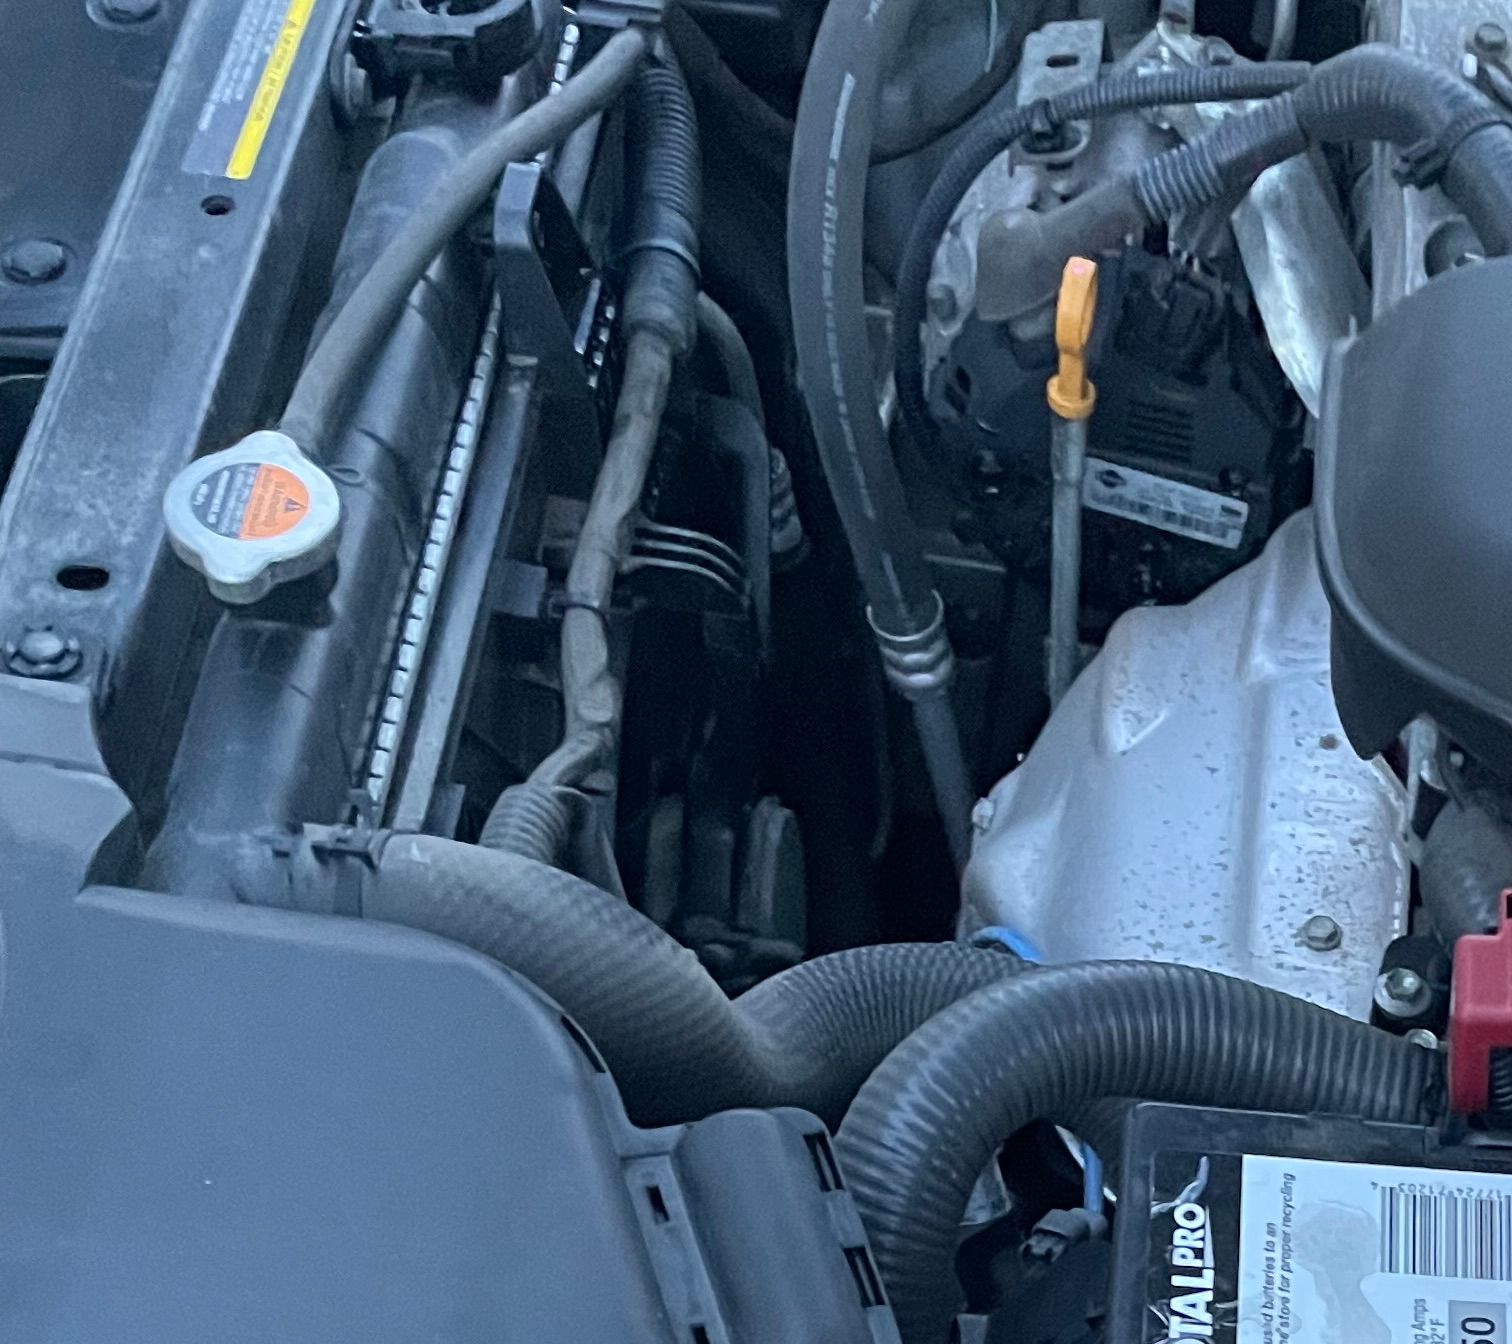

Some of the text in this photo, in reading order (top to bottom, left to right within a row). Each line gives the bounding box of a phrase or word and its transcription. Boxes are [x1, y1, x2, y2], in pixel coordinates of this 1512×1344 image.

[1279, 1172, 1296, 1227] recycling
[1266, 1222, 1277, 1237] an
[1263, 1239, 1275, 1252] to
[1280, 1229, 1294, 1273] proper
[1277, 1273, 1290, 1292] for
[1277, 1296, 1291, 1327] store
[1410, 1298, 1428, 1331] Amps
